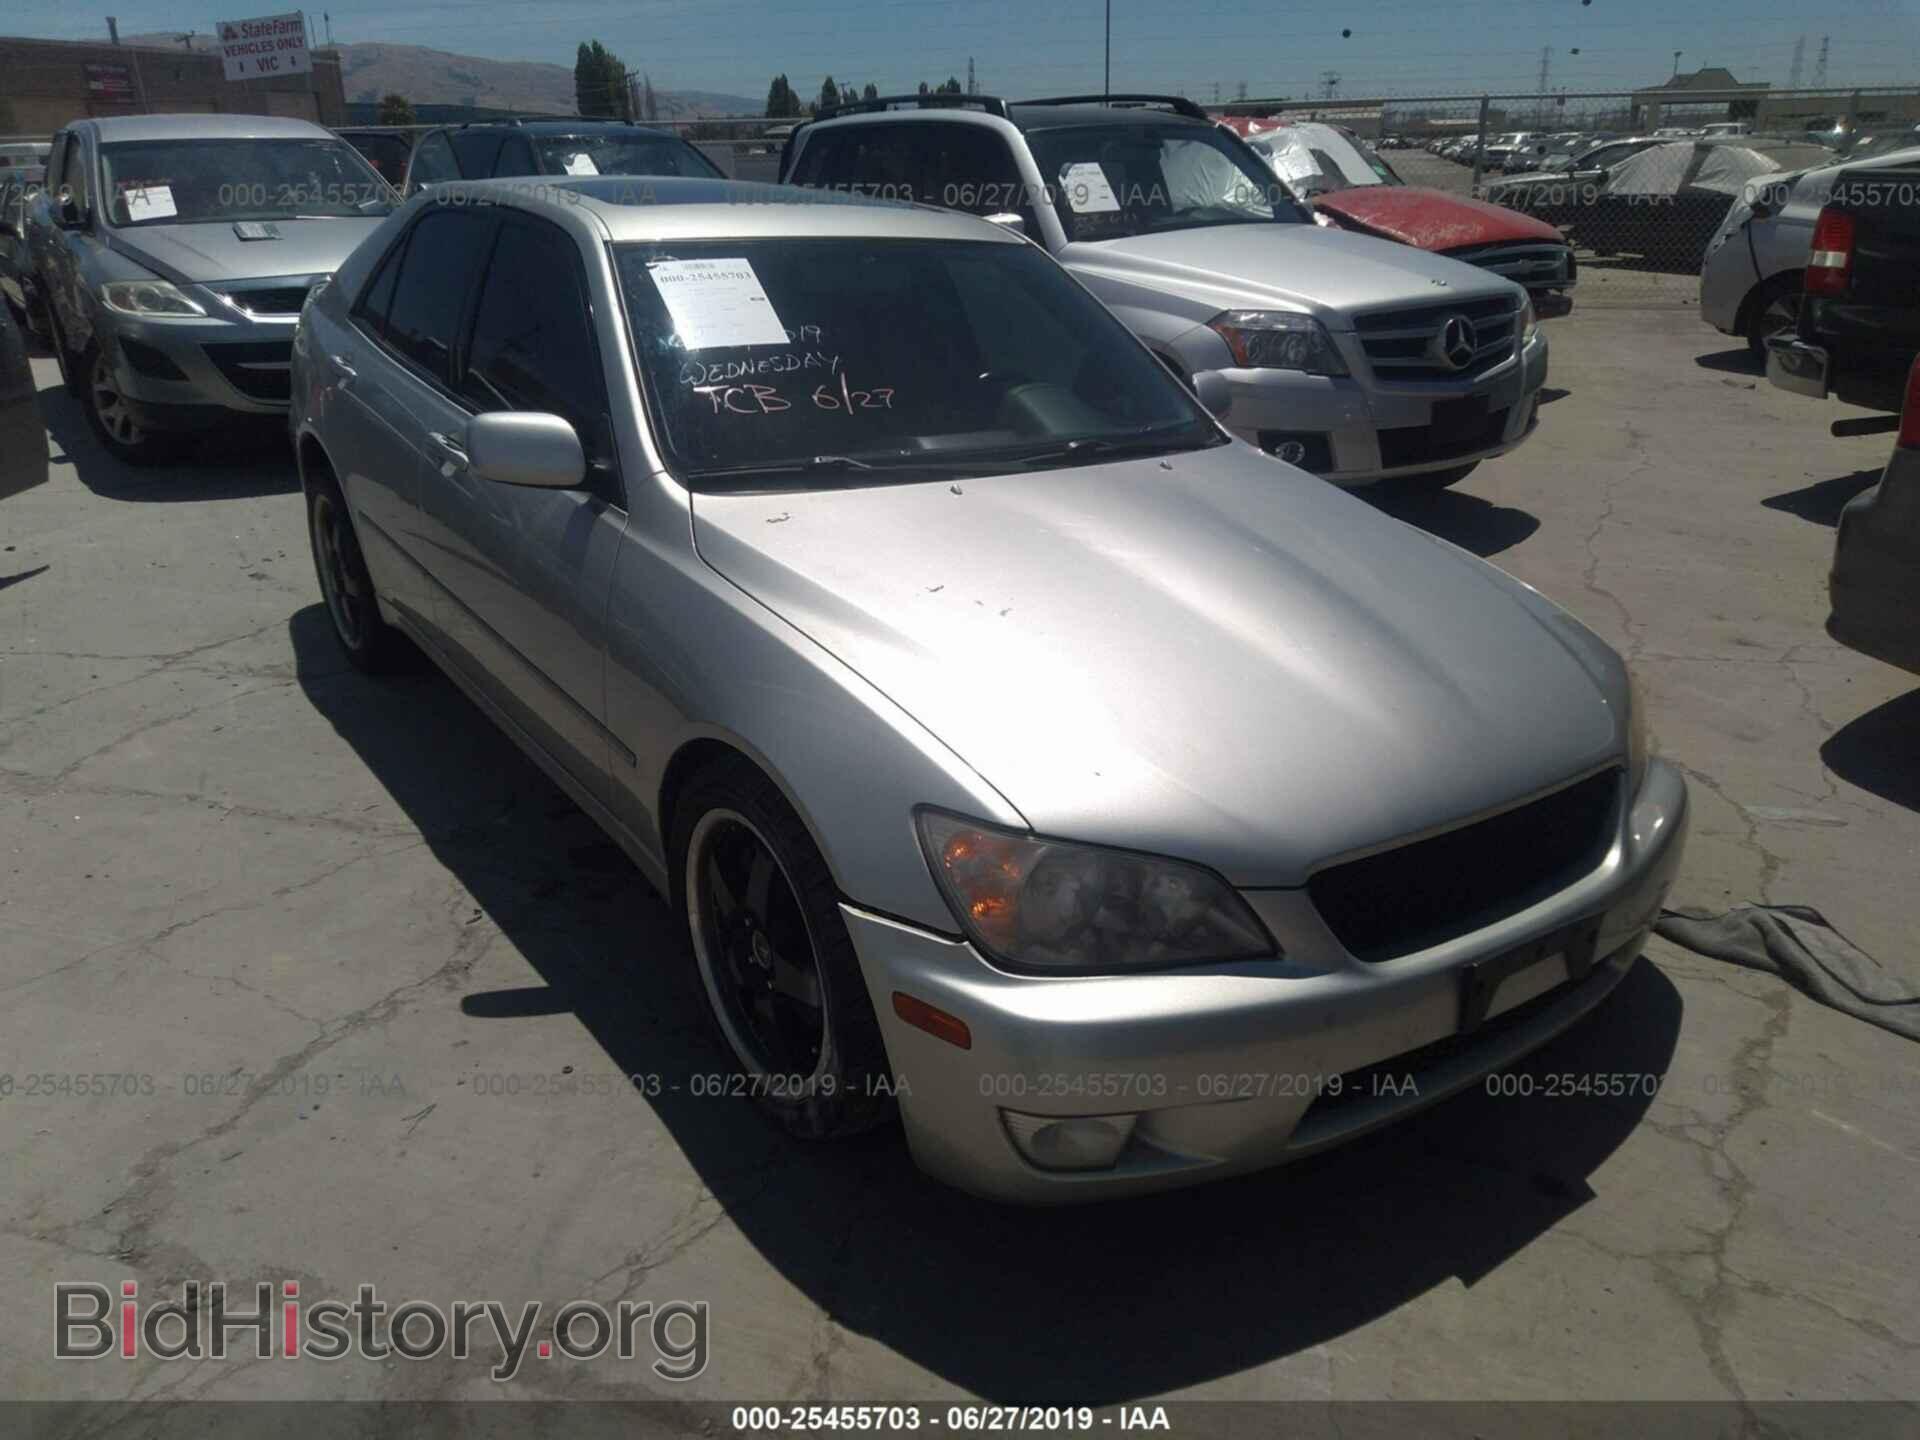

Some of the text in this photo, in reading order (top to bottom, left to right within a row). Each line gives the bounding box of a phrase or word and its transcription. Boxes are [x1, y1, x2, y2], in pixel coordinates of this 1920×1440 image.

[240, 20, 301, 38] StateFarm
[223, 36, 304, 57] VEHICLES ONLY
[256, 56, 279, 72] VIC
[679, 352, 840, 385] WEDNESDAY
[812, 372, 895, 415] 6/27
